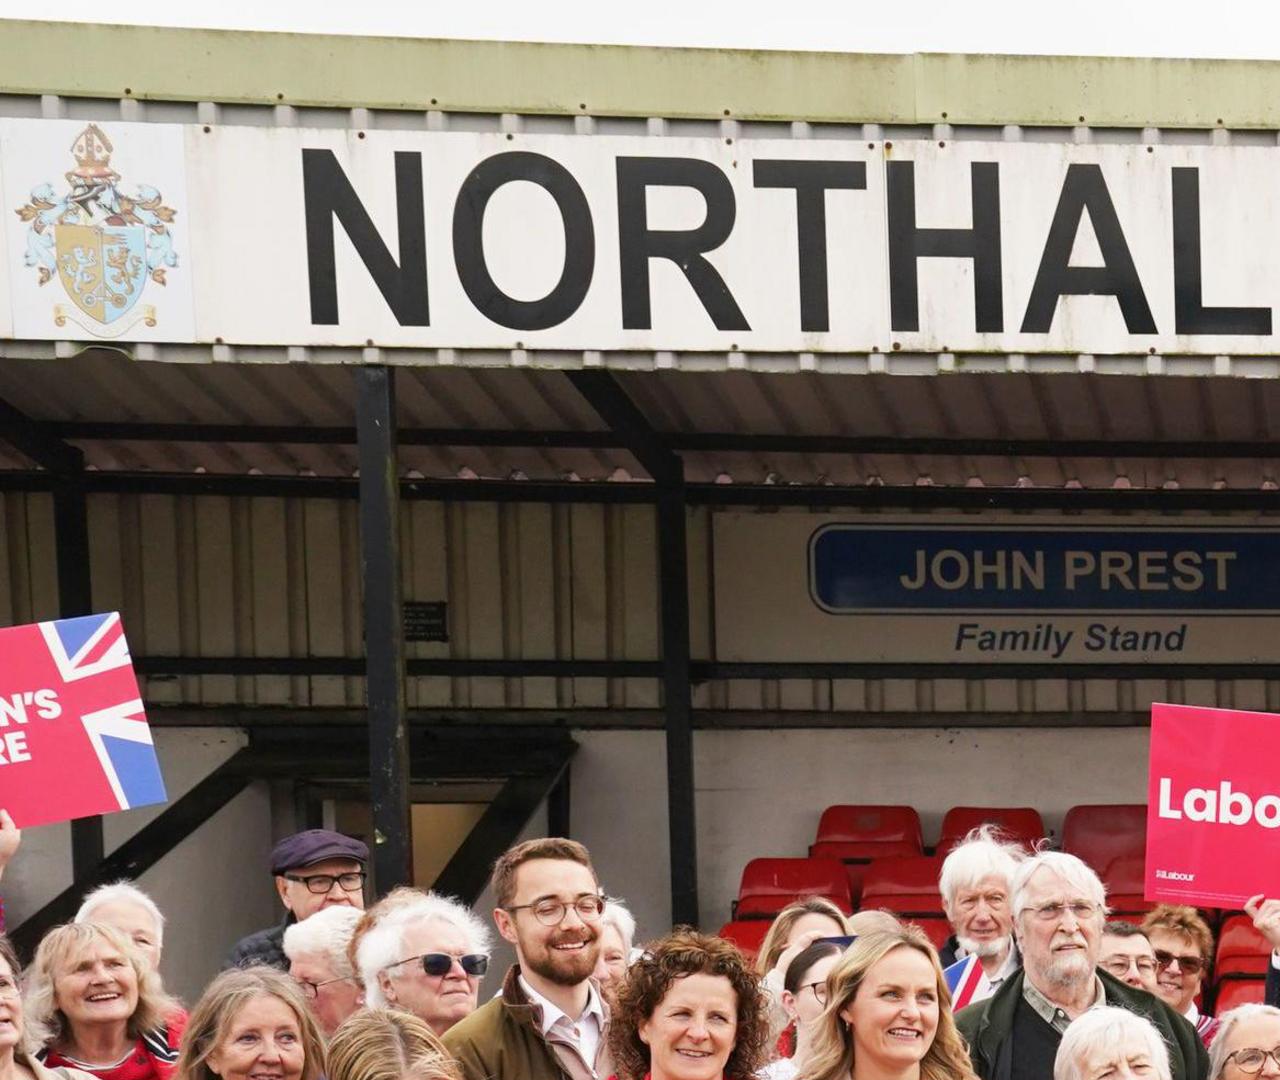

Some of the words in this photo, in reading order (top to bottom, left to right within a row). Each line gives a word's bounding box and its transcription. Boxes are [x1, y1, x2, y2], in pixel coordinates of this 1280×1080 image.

[900, 549, 1045, 591] JOHN
[1065, 550, 1237, 592] PREST
[954, 622, 1073, 659] Family
[1084, 623, 1187, 653] Stand
